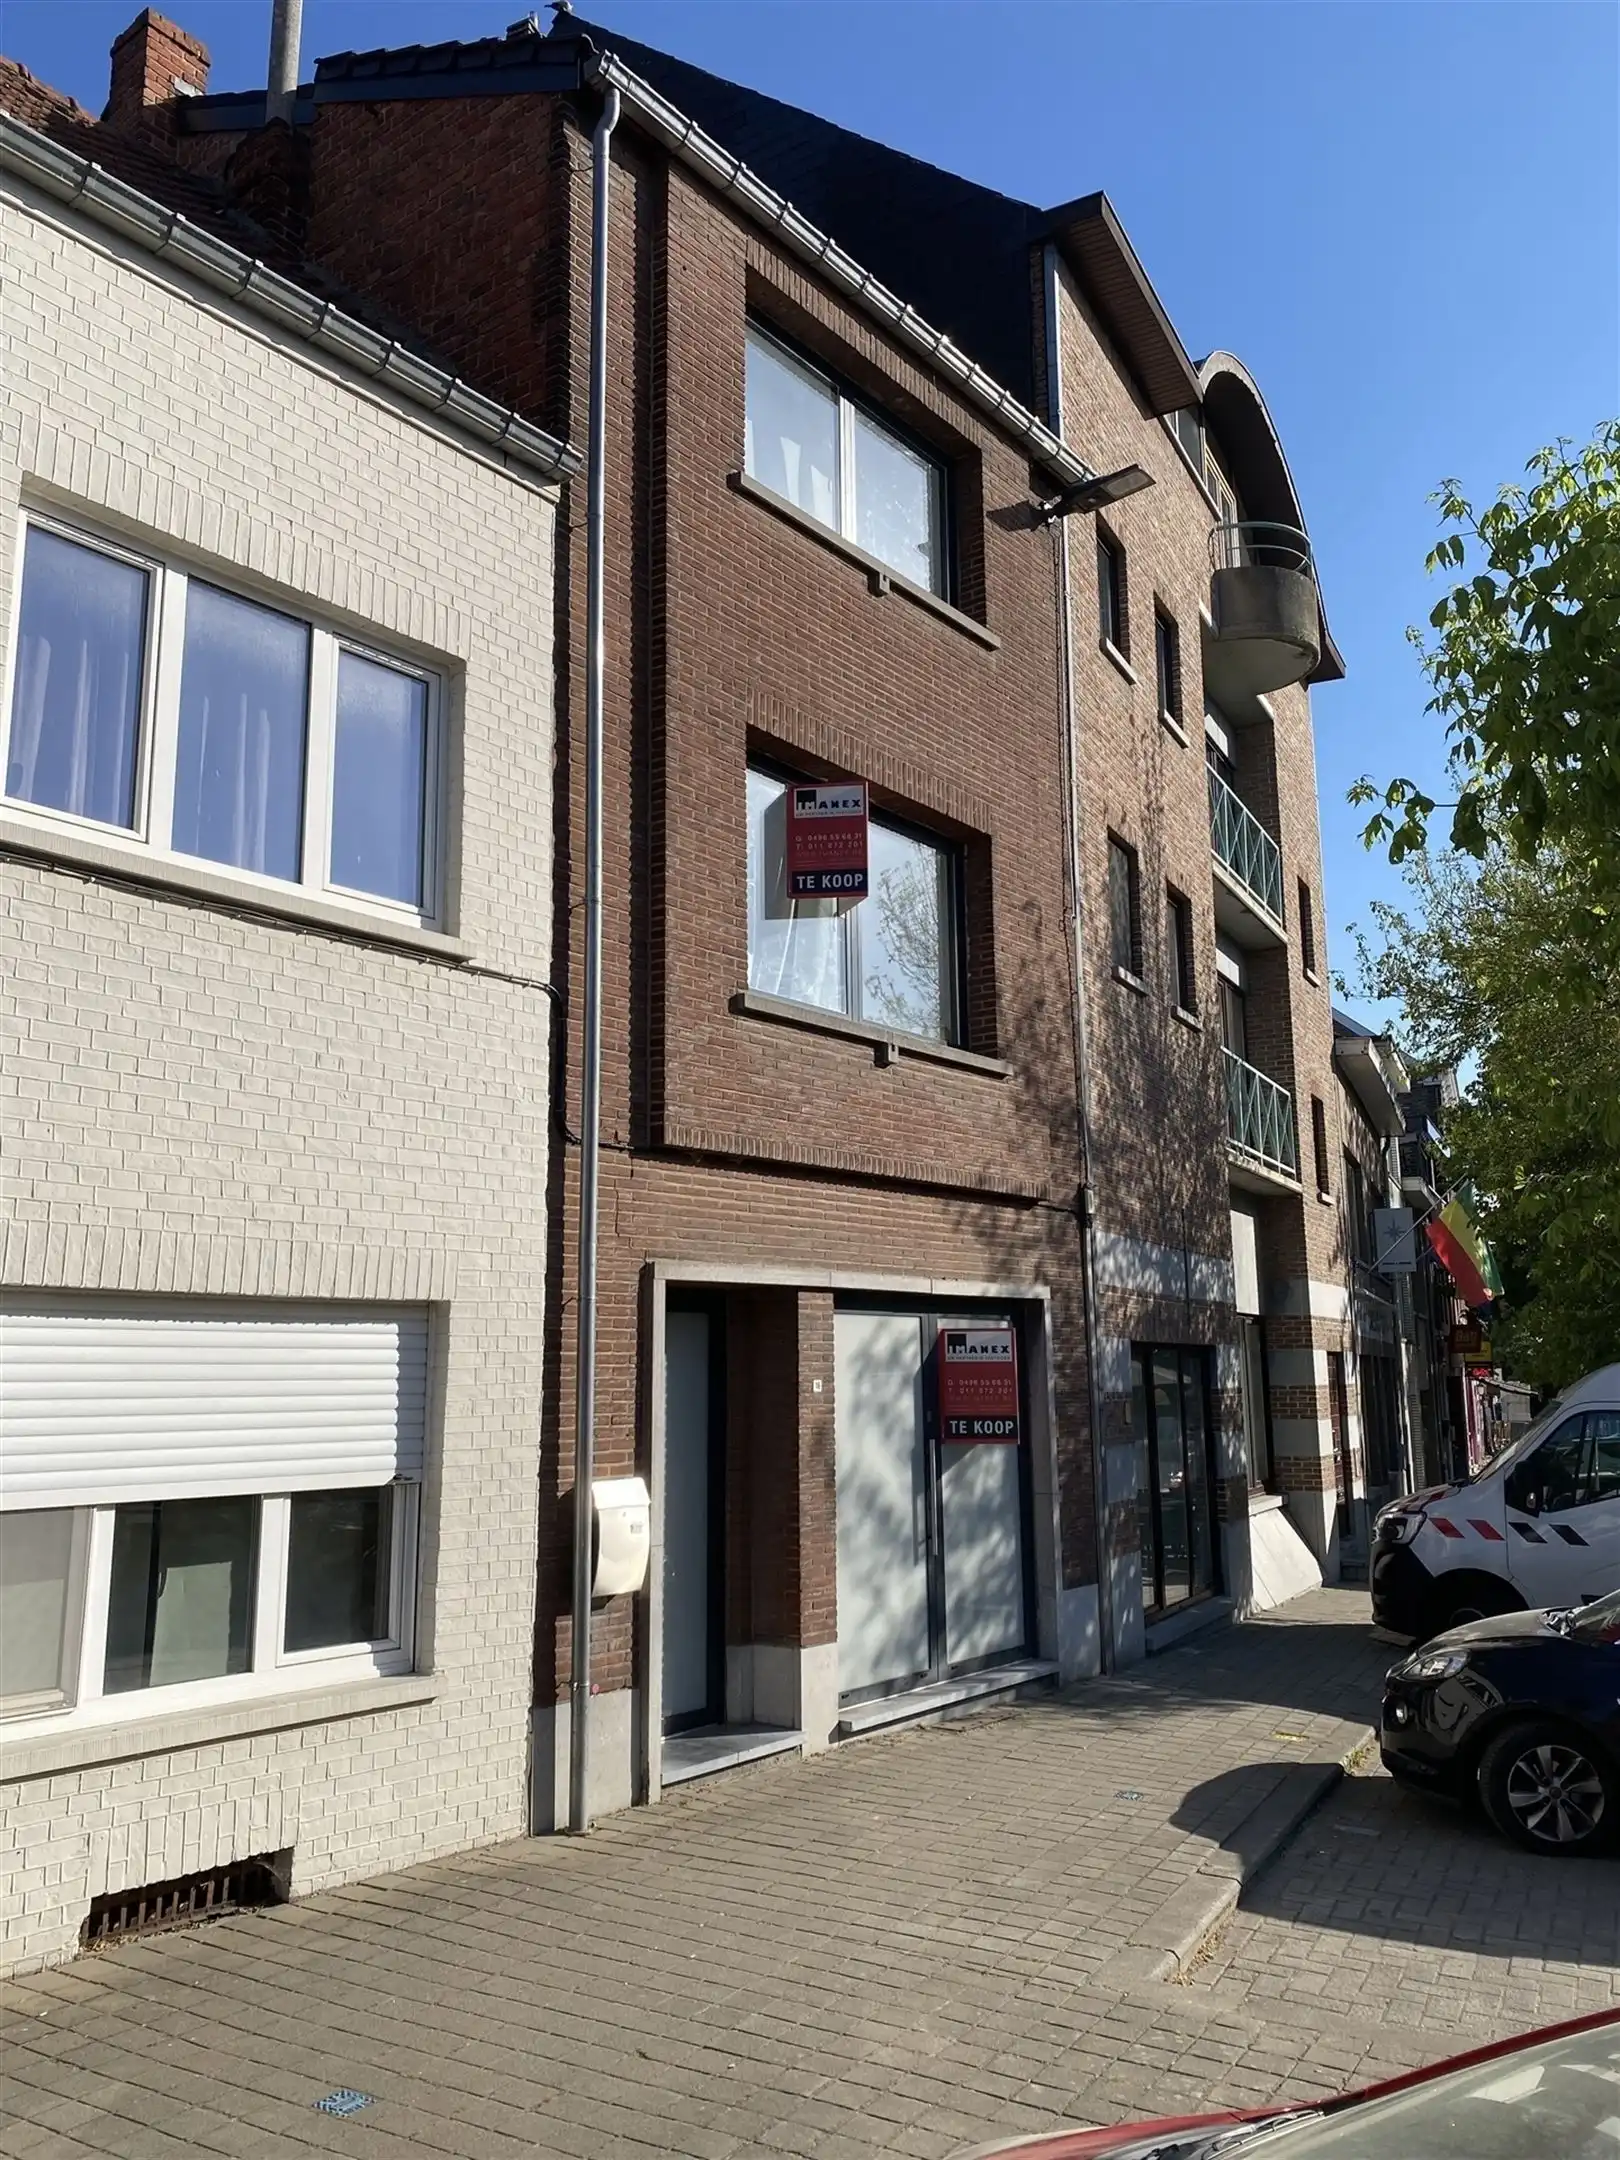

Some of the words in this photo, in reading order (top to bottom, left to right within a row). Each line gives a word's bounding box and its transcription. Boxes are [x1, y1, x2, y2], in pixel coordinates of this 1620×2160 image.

[796, 875, 815, 889] TE
[822, 874, 863, 888] KOOP
[949, 1420, 967, 1434] TE
[974, 1420, 1014, 1434] KOOP
